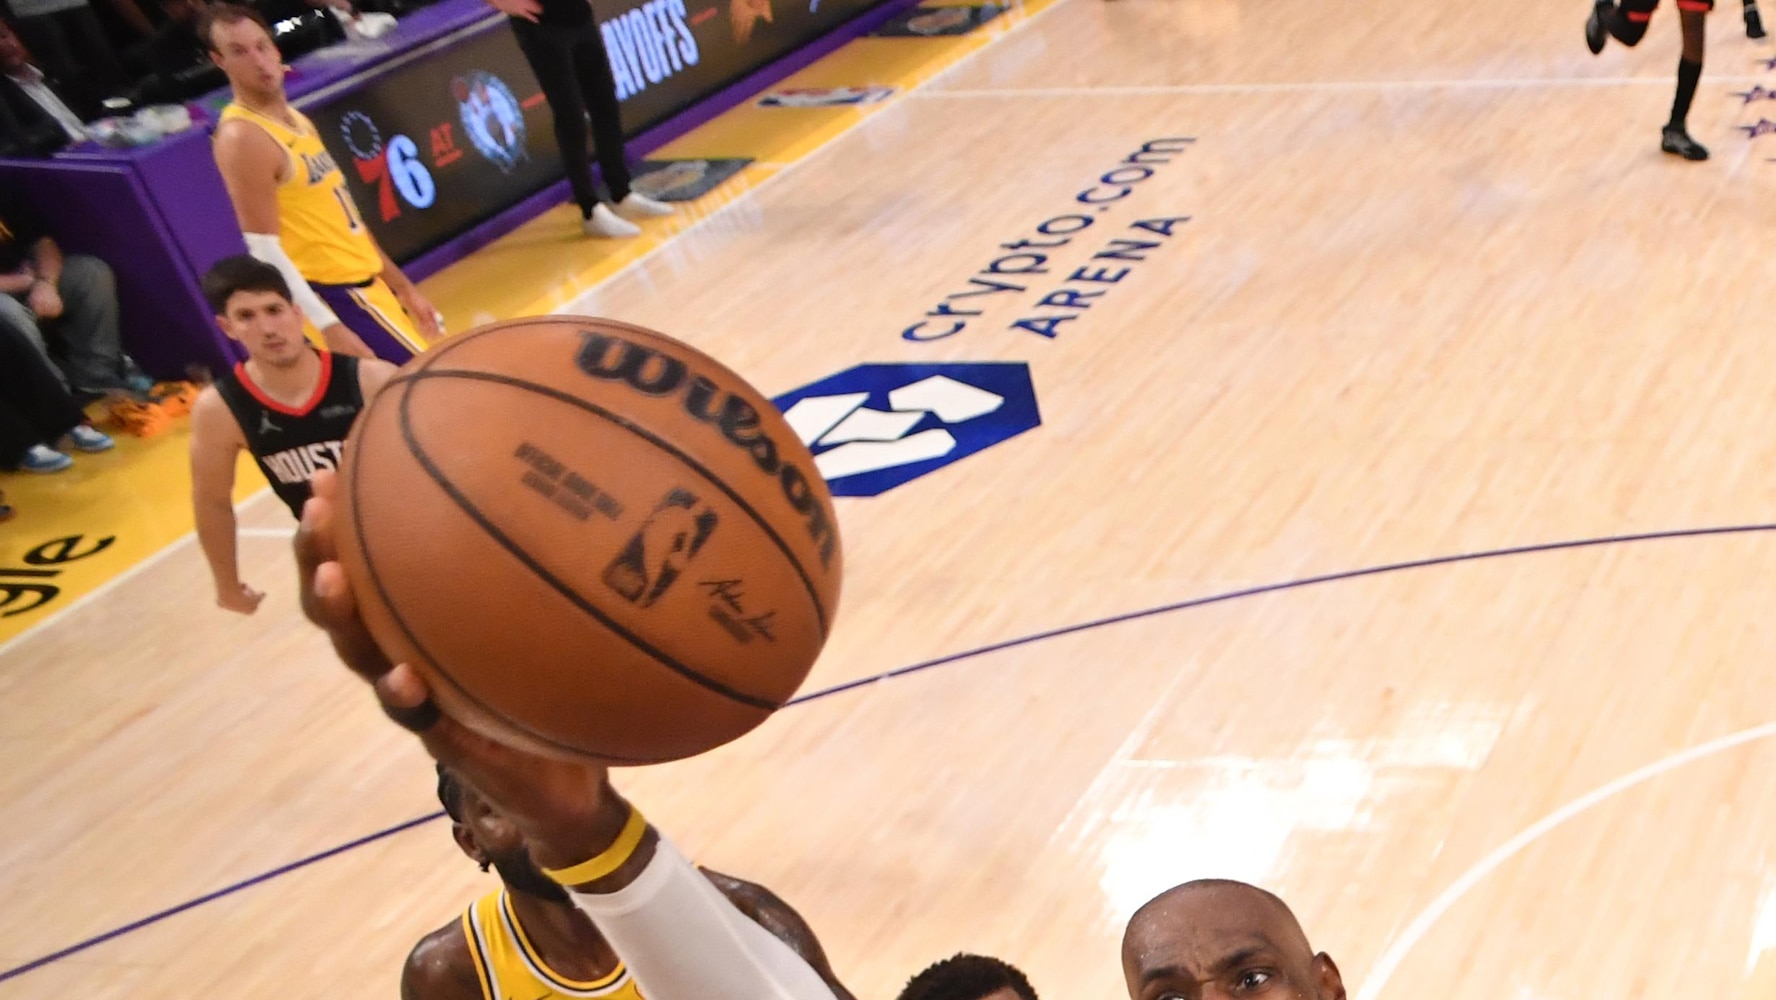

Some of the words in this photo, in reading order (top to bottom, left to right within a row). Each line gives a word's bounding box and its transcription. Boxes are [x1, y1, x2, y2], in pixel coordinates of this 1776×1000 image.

[354, 134, 437, 223] 76
[902, 136, 1197, 344] crypto.com
[1009, 215, 1193, 340] ARENA
